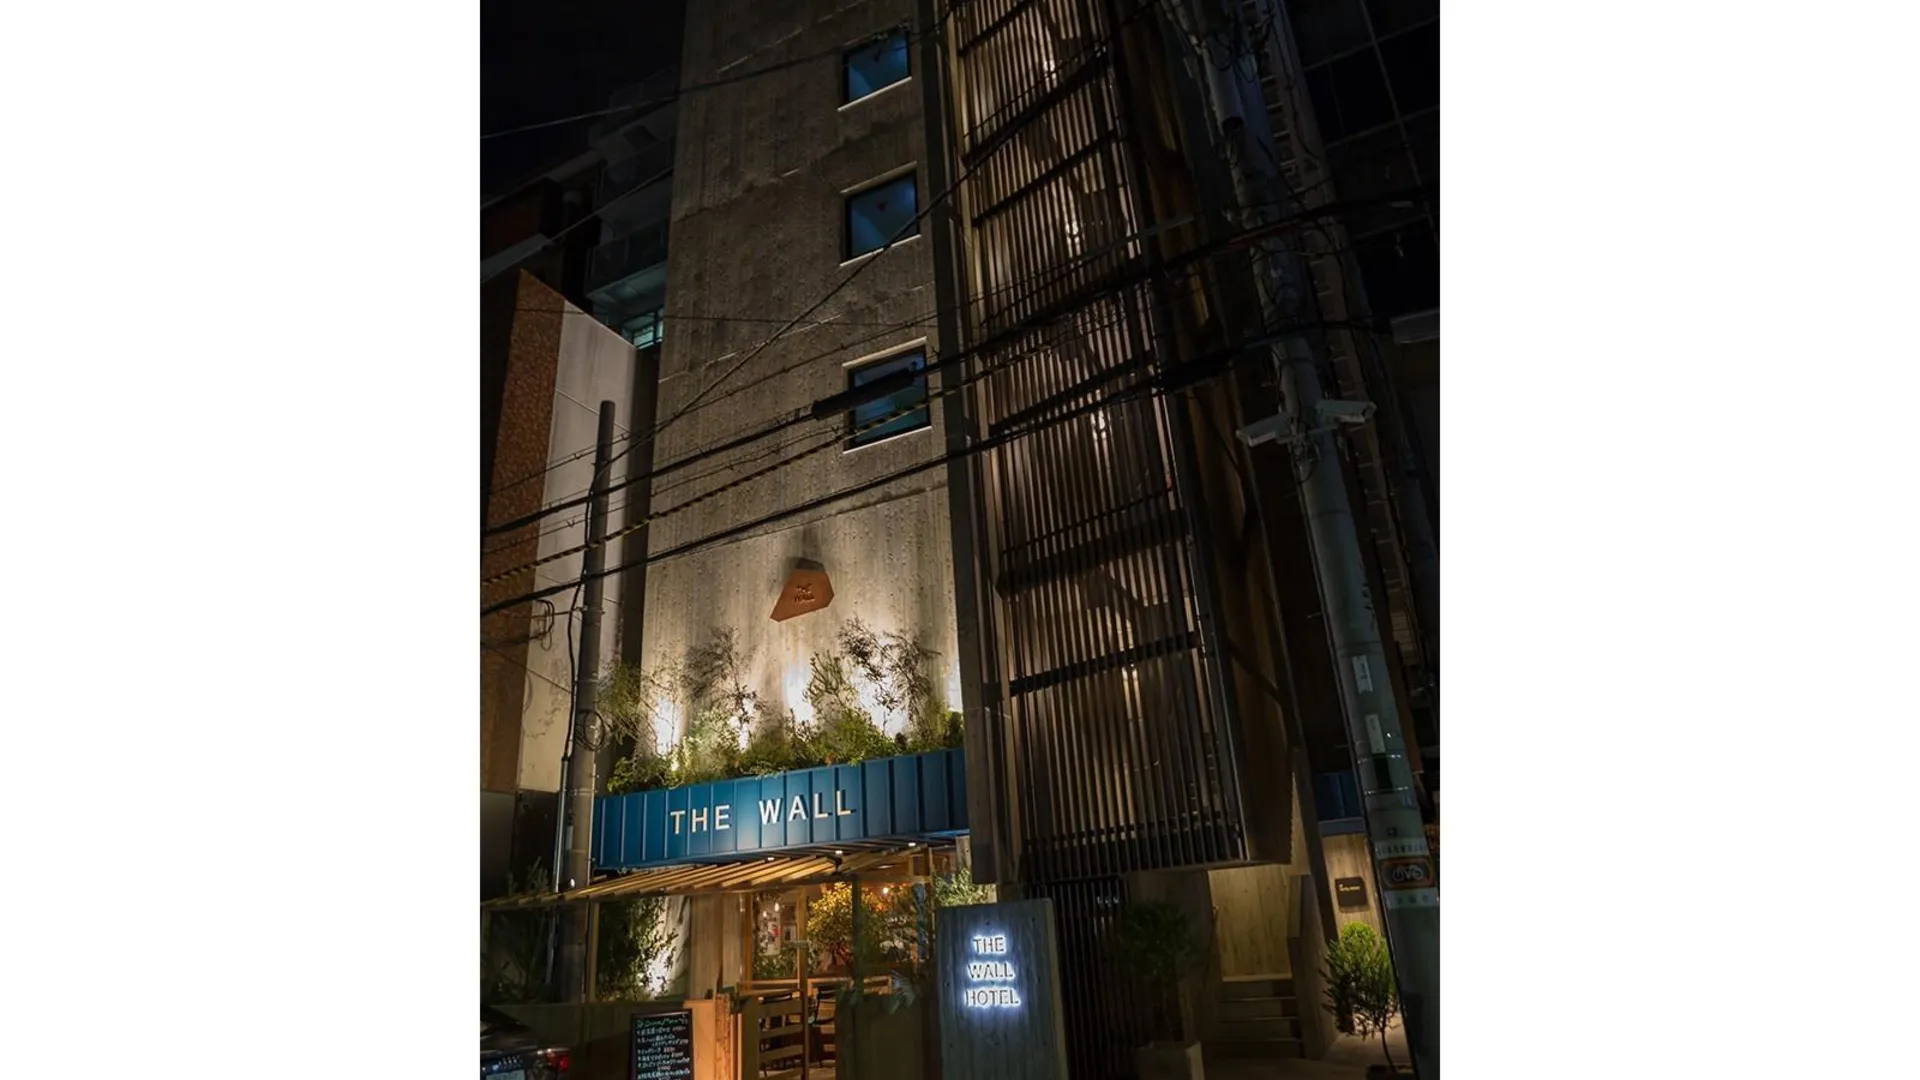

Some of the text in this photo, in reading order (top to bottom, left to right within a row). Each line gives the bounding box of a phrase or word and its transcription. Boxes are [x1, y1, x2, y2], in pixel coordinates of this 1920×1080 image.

[669, 790, 852, 835] THE WALL
[973, 936, 1006, 953] THE
[968, 962, 1014, 979] WALL
[965, 989, 1020, 1007] HOTEL
